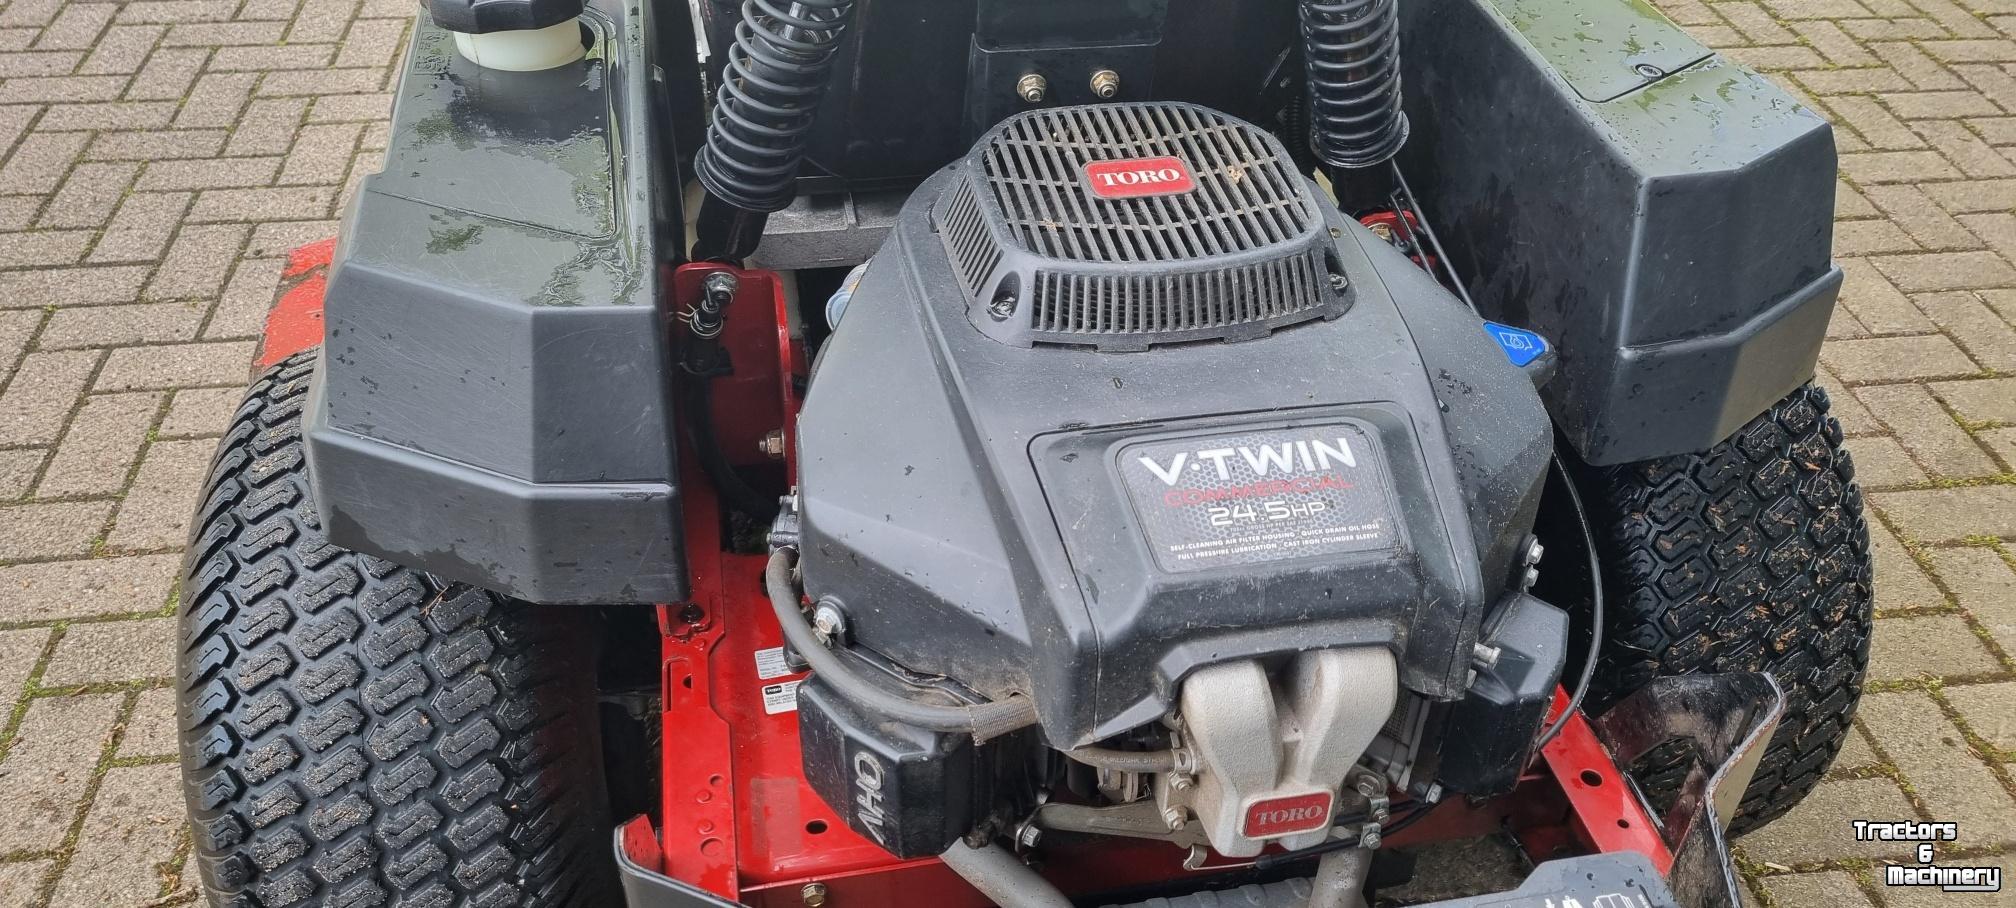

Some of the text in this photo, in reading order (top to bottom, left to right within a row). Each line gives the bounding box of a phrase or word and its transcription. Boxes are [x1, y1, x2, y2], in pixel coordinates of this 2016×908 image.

[1096, 168, 1181, 187] TORO
[1164, 473, 1354, 508] COMMERCIAL
[1170, 539, 1223, 552] SELF-CLEANING
[1225, 537, 1238, 545] AIR
[1238, 535, 1261, 544] FILTER
[1262, 531, 1296, 541] HOUSING
[1301, 528, 1324, 537] QUICK
[1325, 526, 1347, 534] DRAIN
[1348, 524, 1361, 532] OIL
[1177, 532, 1379, 561] FULL PRESSURE LUBRICATION CAST IRON CYLINDER SLEEVE
[854, 751, 885, 845] OHV
[1256, 805, 1323, 826] TORO
